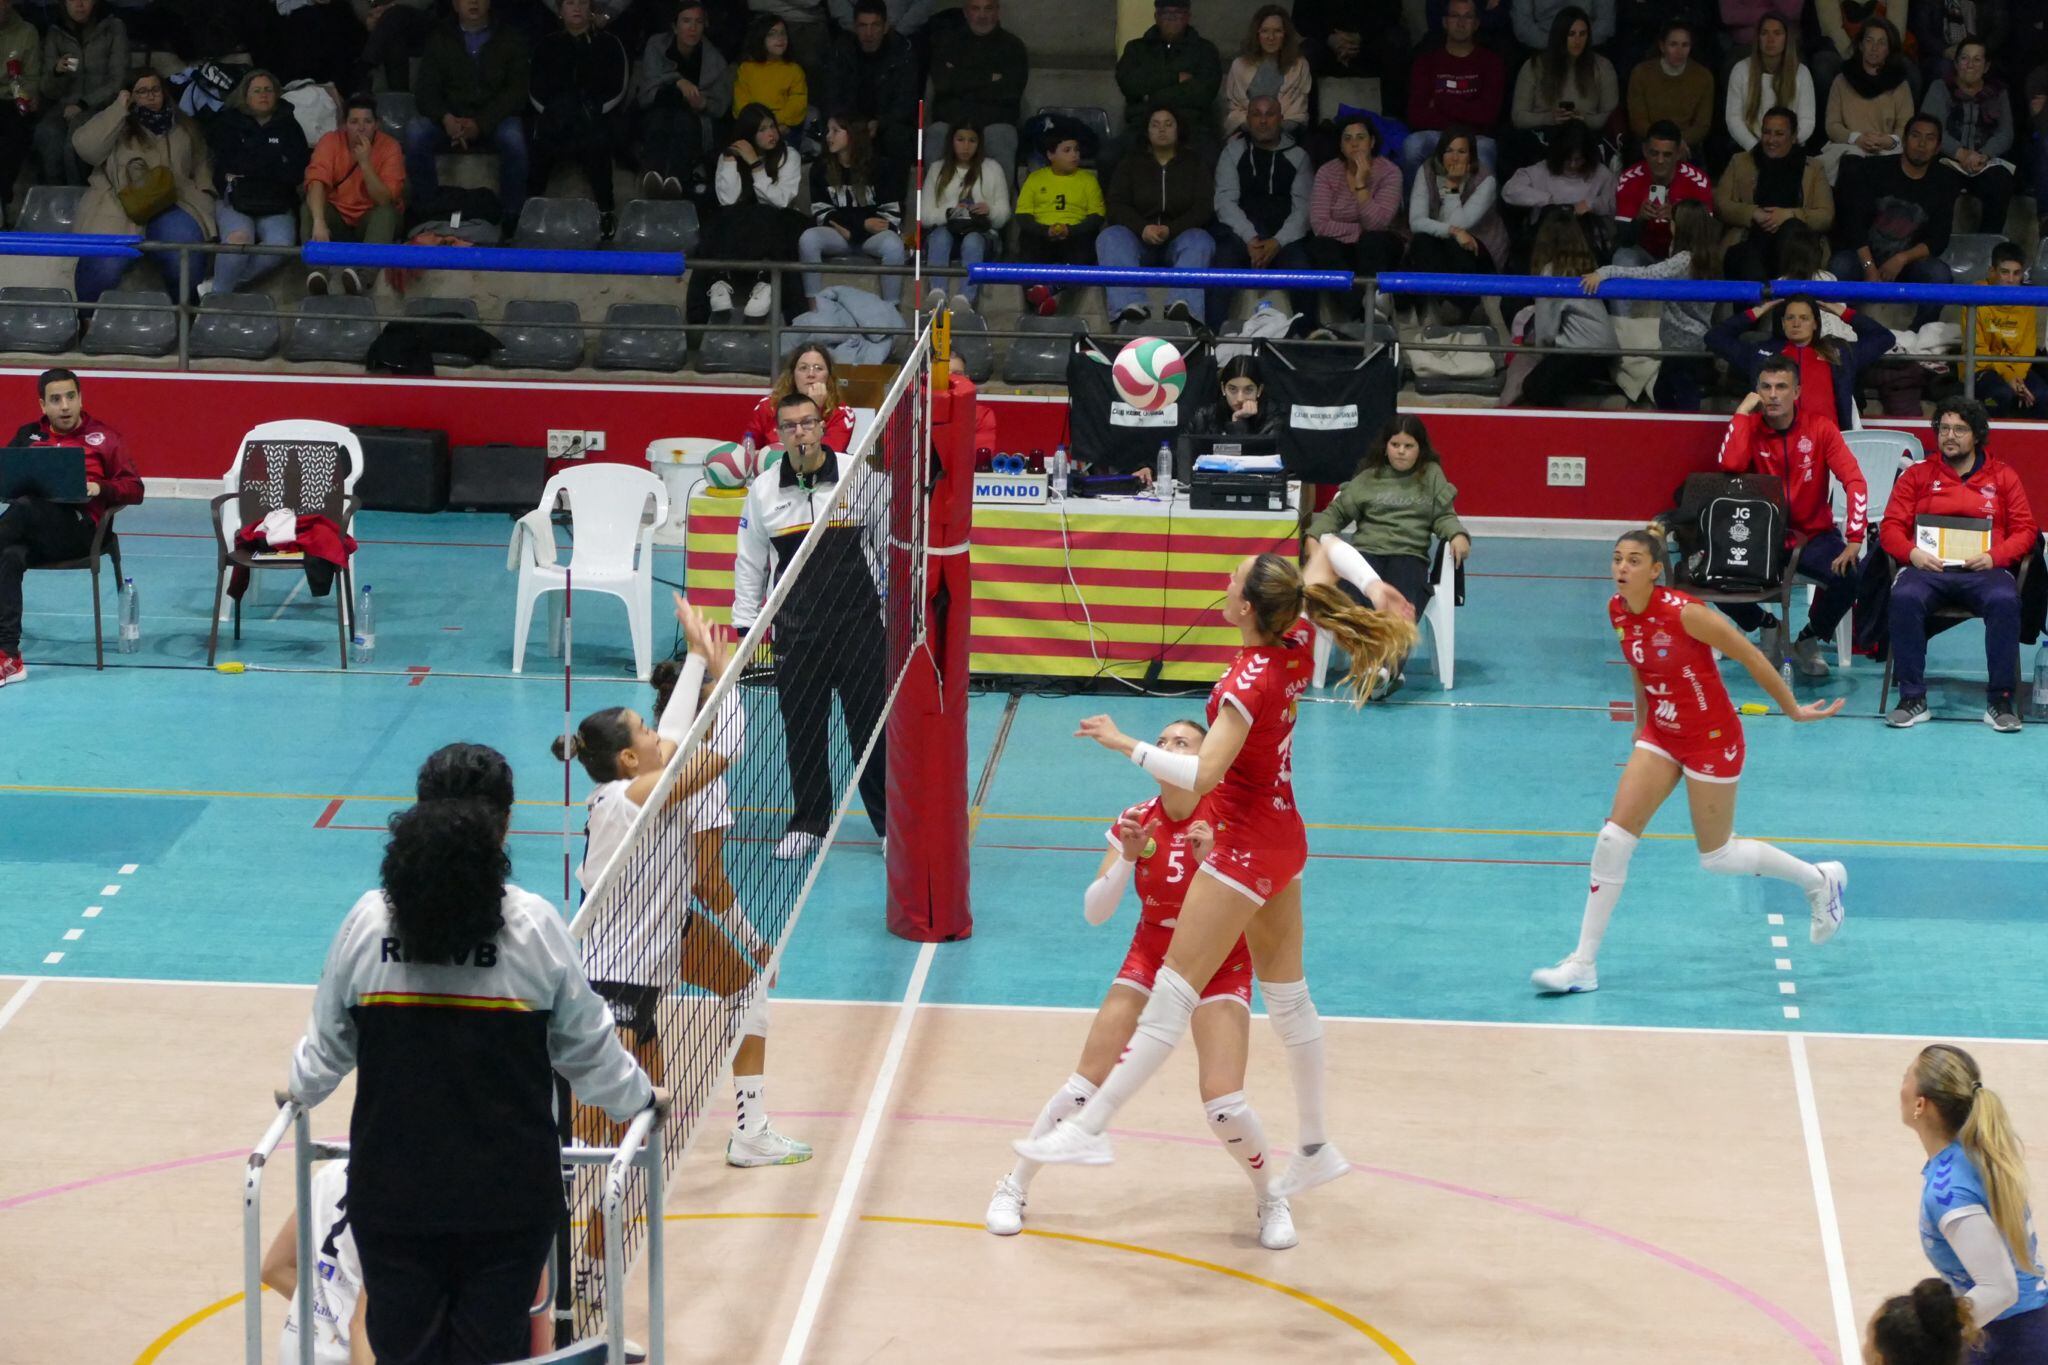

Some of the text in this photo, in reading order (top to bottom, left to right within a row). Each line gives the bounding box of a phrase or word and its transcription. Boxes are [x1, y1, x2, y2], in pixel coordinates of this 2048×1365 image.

[1055, 194, 1066, 211] 3
[976, 484, 1040, 497] MONDO
[1732, 507, 1751, 520] JG
[1631, 640, 1645, 664] 6
[1166, 850, 1185, 883] 5
[381, 936, 498, 968] RVB
